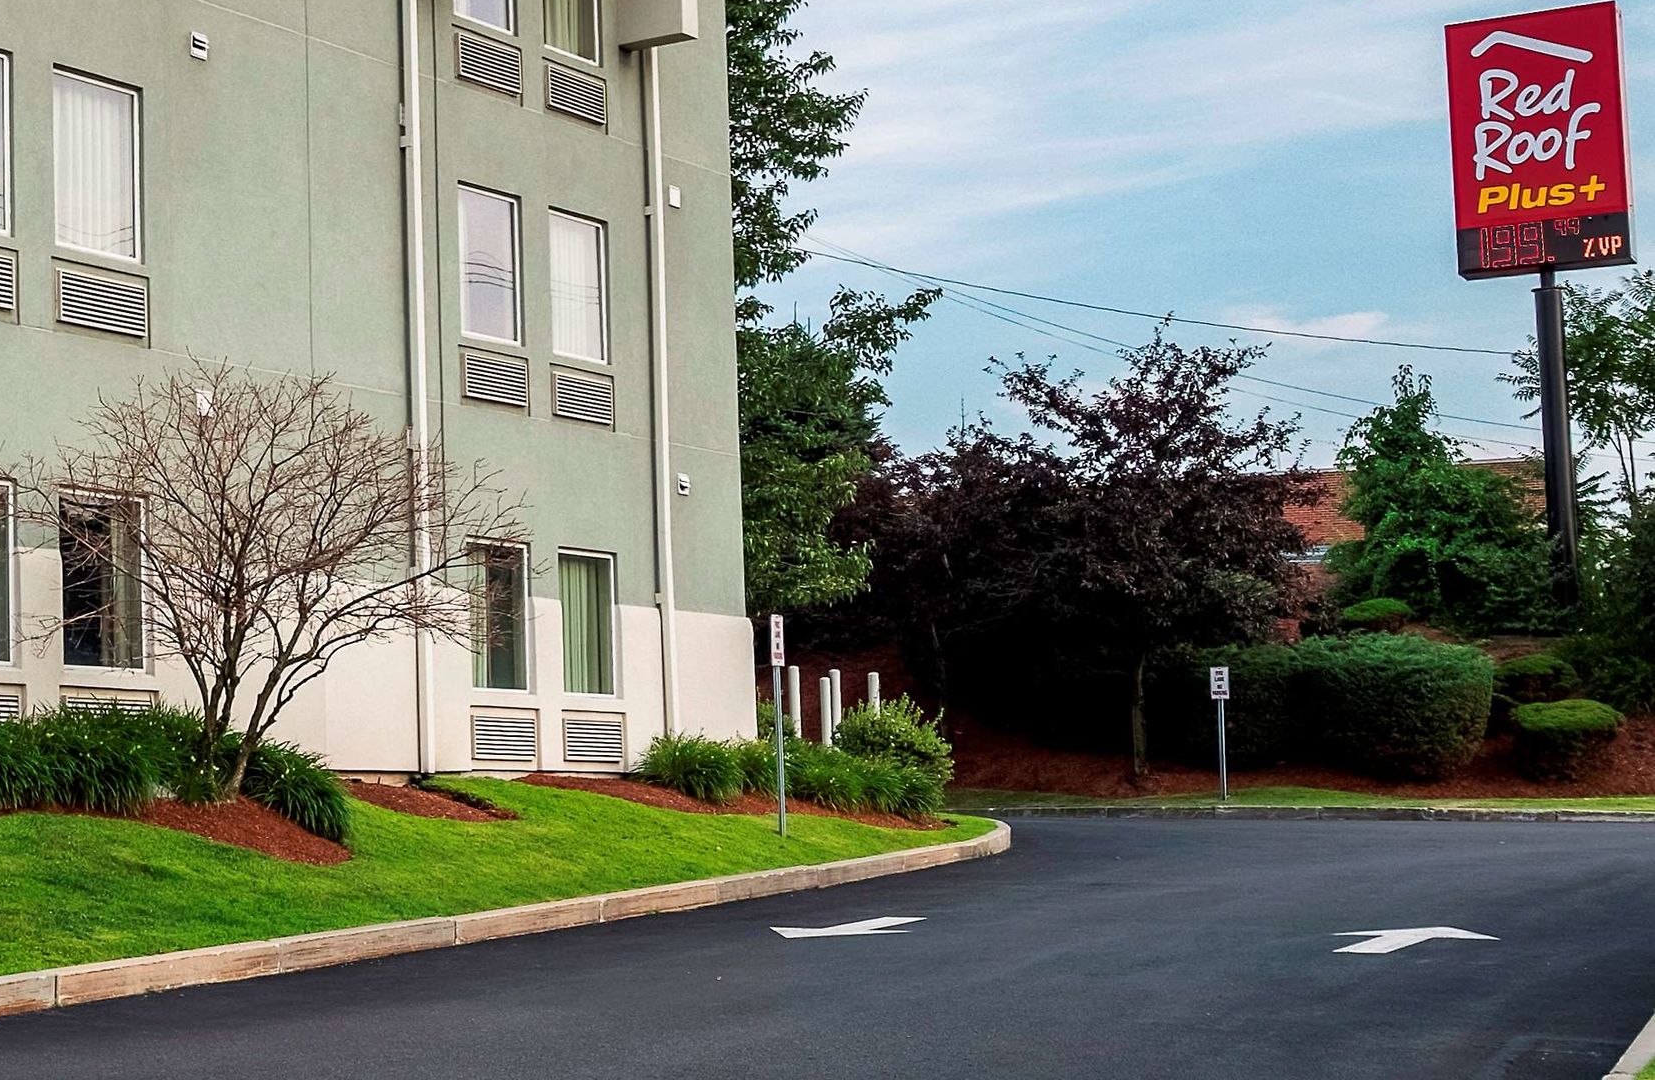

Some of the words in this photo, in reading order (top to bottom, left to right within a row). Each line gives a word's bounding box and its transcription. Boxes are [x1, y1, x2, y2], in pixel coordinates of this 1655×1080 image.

[1479, 68, 1575, 121] Red
[1473, 102, 1601, 181] Roof
[1477, 175, 1605, 214] Plus+
